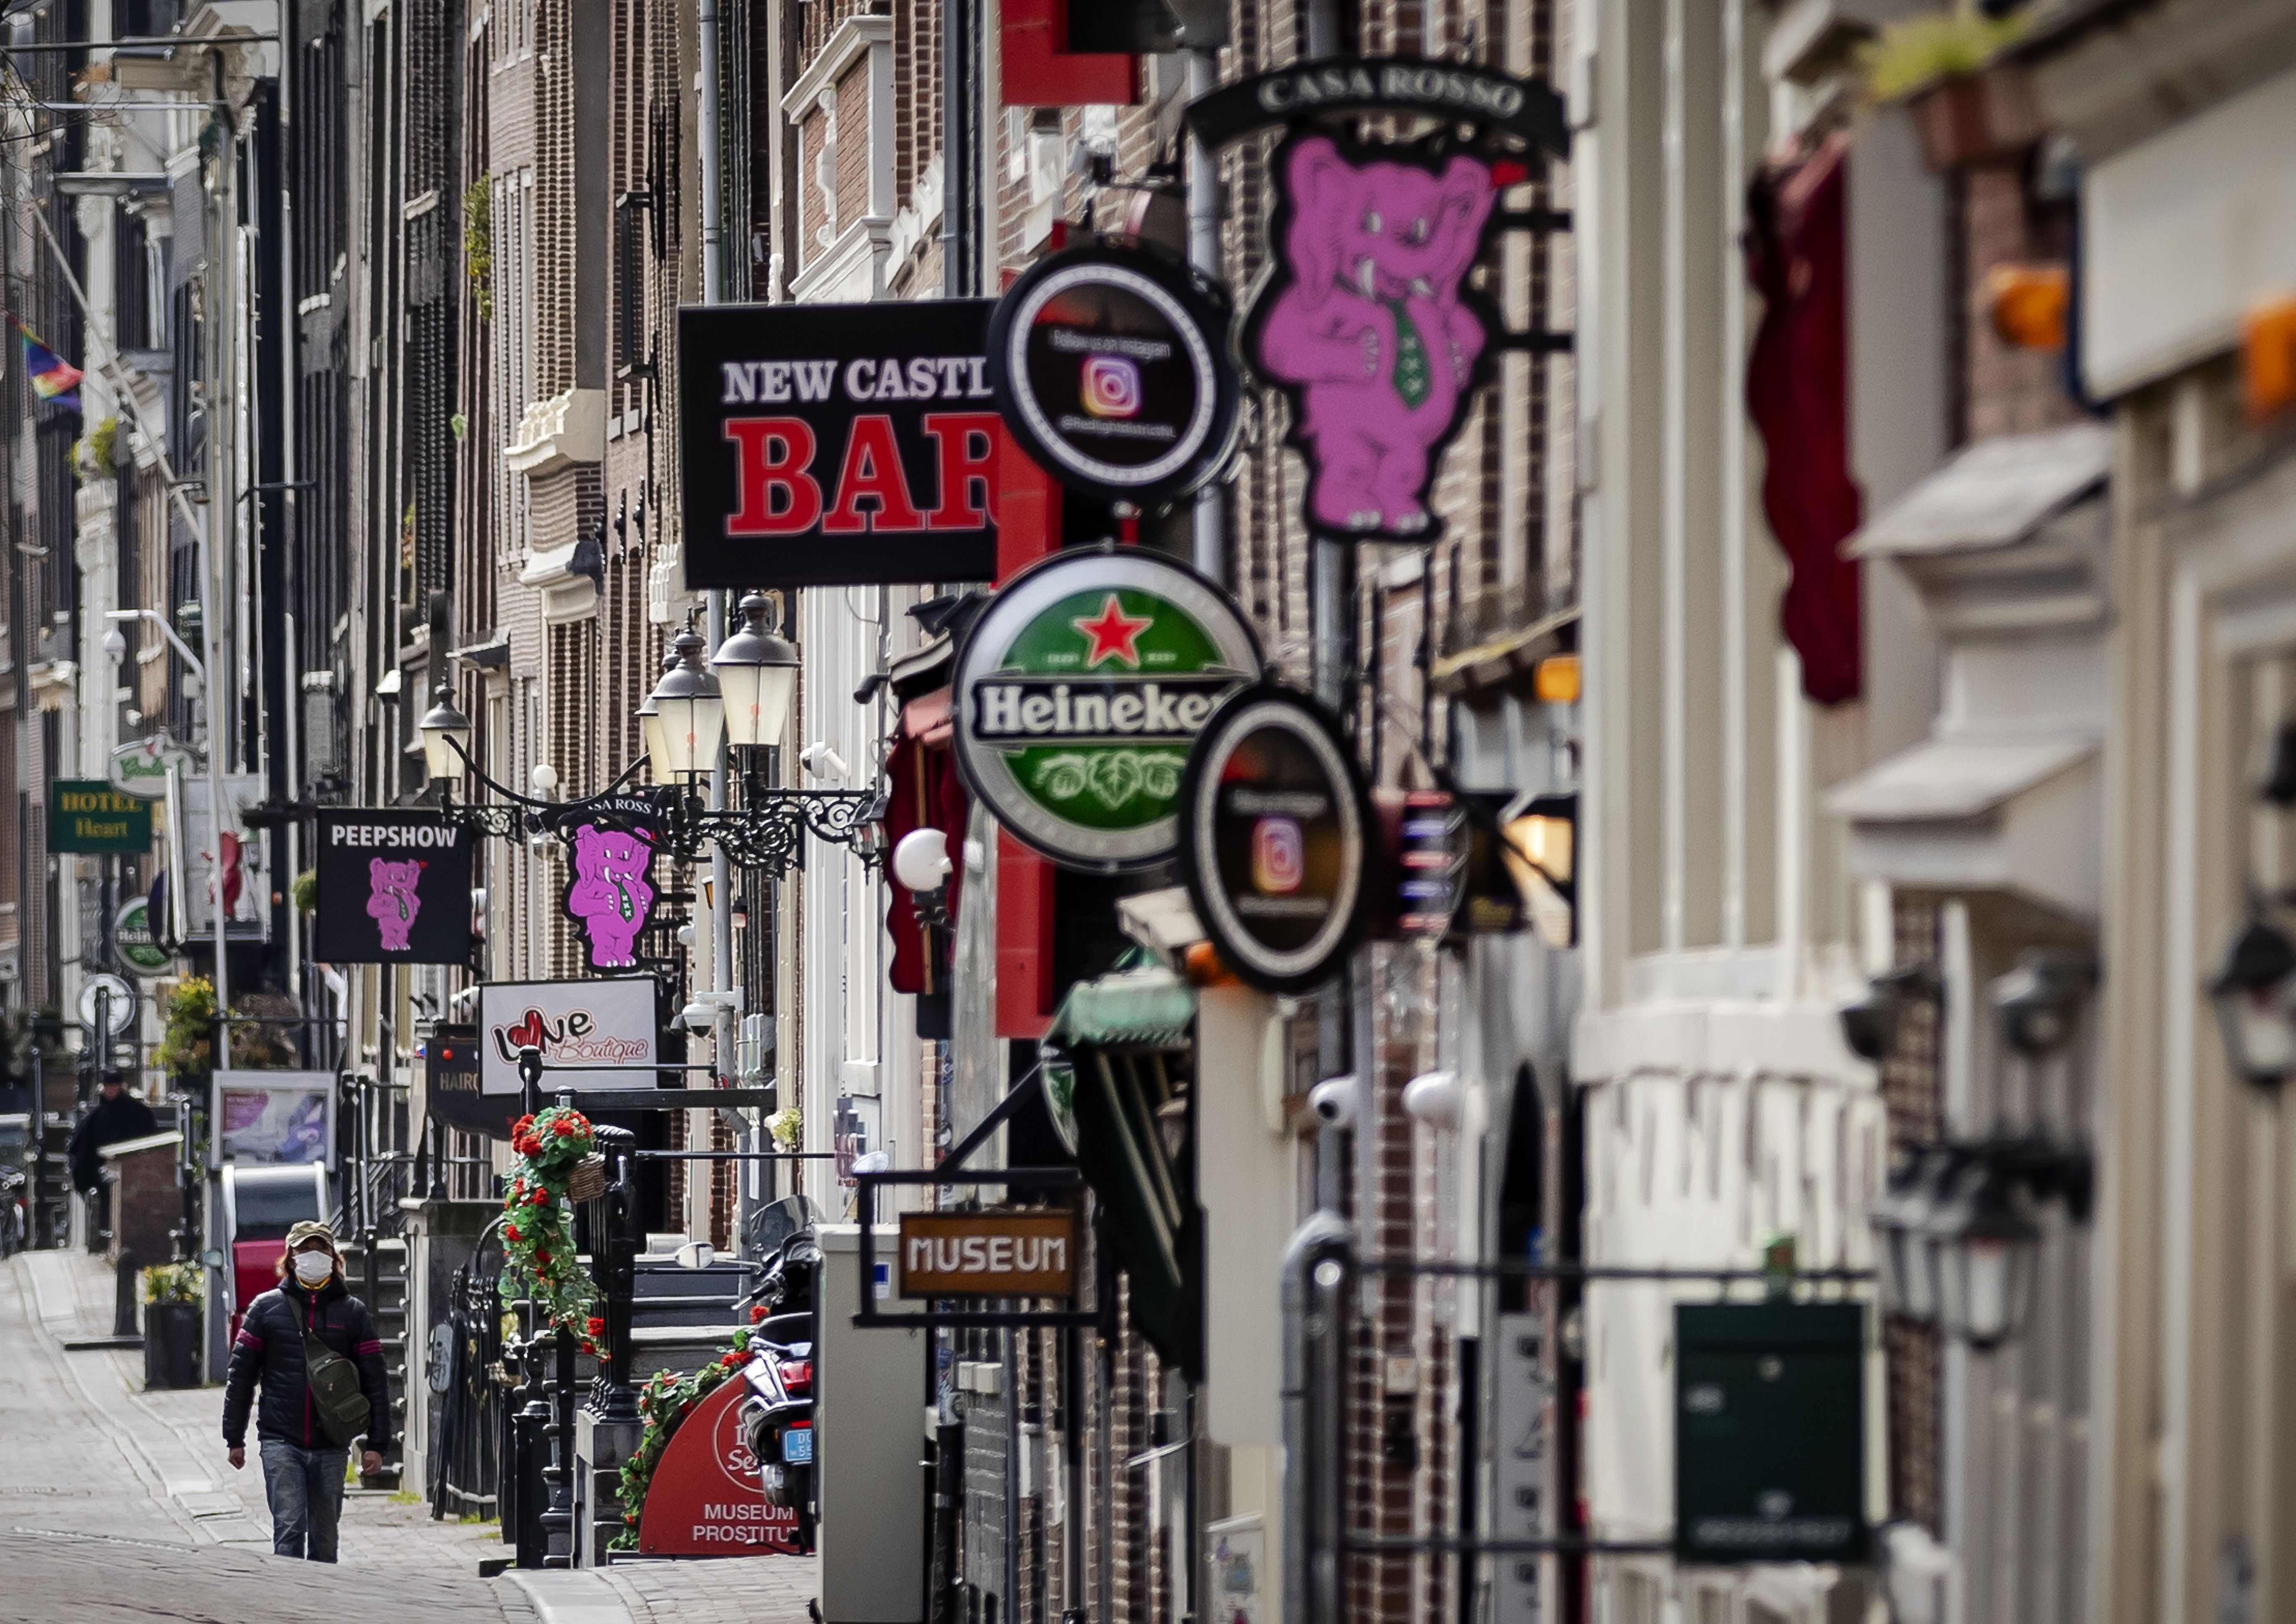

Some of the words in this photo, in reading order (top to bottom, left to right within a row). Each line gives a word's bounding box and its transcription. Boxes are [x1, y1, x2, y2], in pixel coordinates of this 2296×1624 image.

[1259, 68, 1373, 109] CASA
[1381, 68, 1522, 117] ROSSO
[722, 361, 838, 403] NEW
[61, 792, 143, 812] HOTEL
[331, 824, 458, 847] PEEPSHOW
[908, 1236, 1066, 1273] MUSEUM
[704, 1504, 793, 1520] MUSEUM
